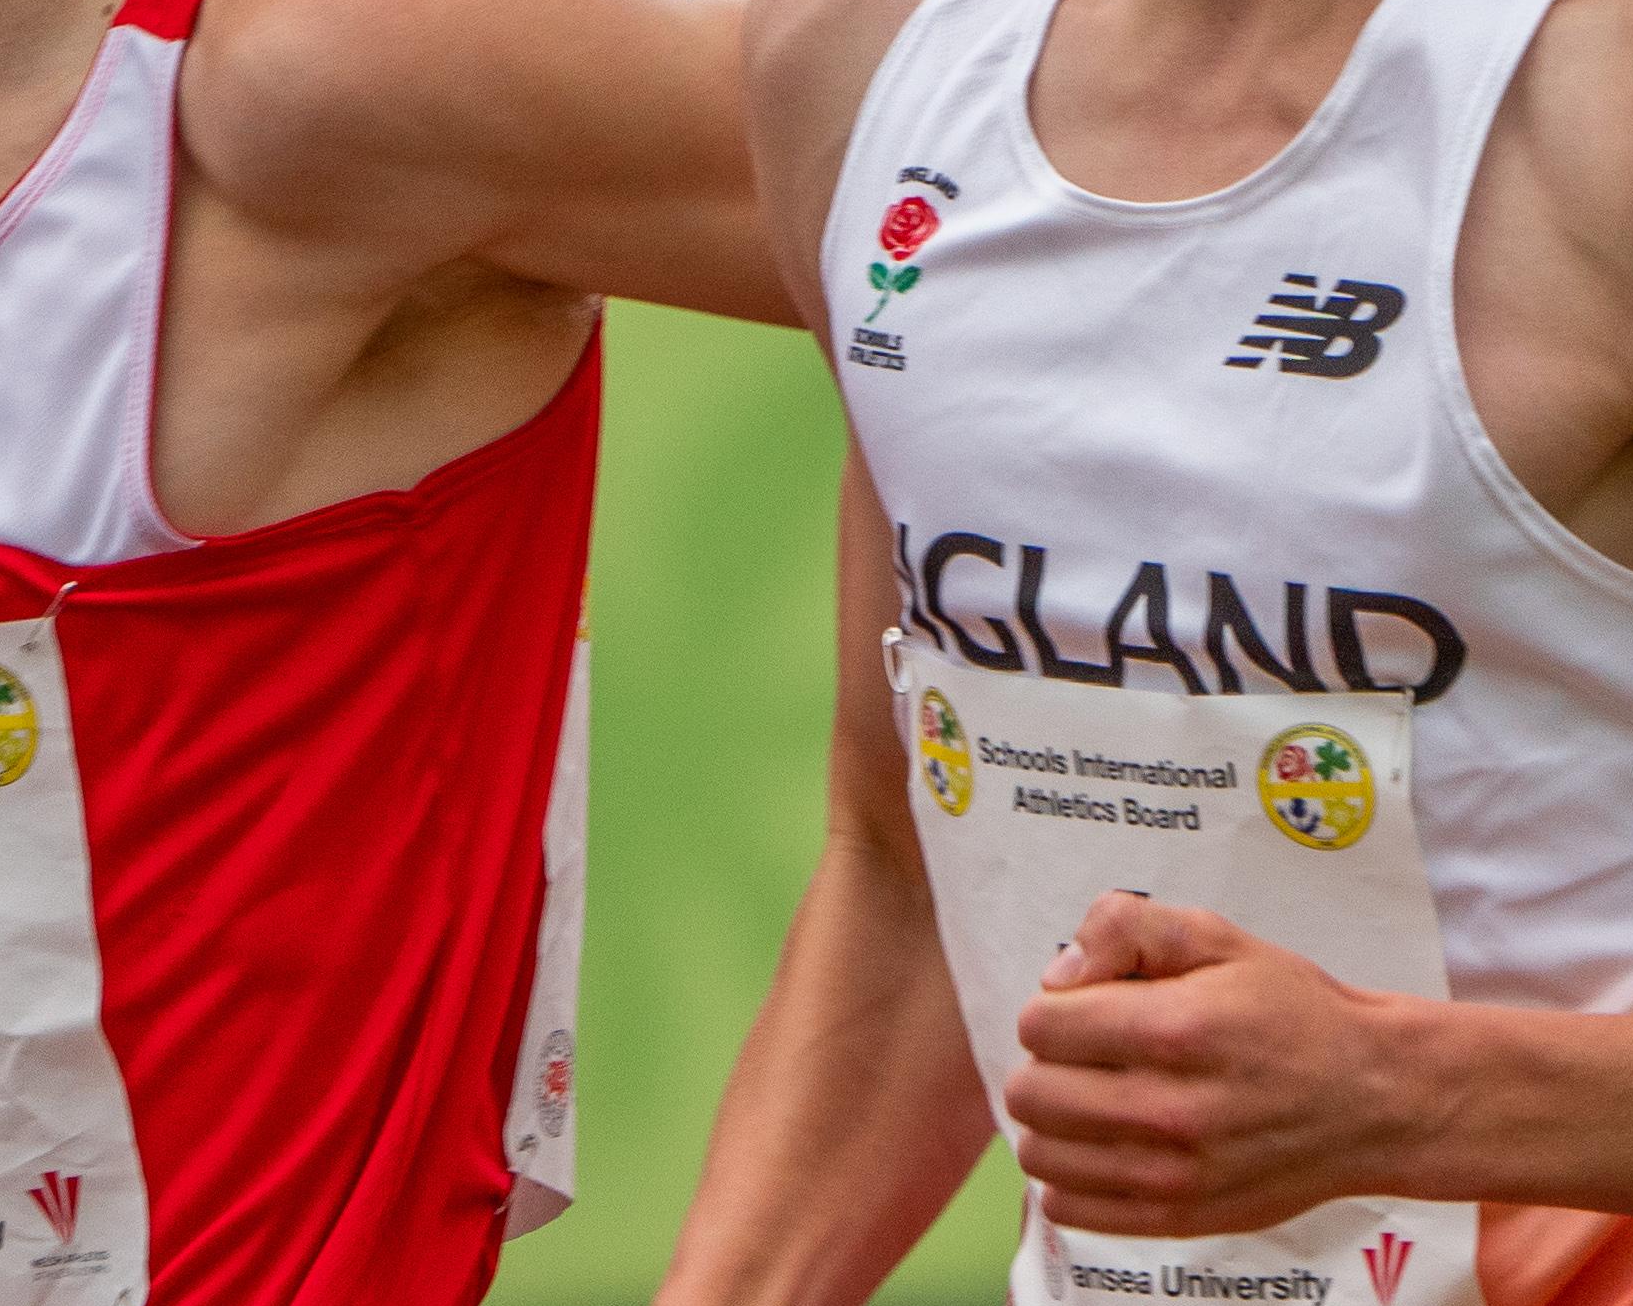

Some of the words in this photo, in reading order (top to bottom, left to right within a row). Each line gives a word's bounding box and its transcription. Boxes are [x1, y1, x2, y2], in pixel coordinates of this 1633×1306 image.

[977, 736, 1068, 775] Schools
[1071, 748, 1238, 789] International
[1013, 784, 1119, 823] Athletics
[1122, 796, 1202, 831] Board
[1070, 1263, 1152, 1295] ansea
[1160, 1264, 1334, 1306] University
